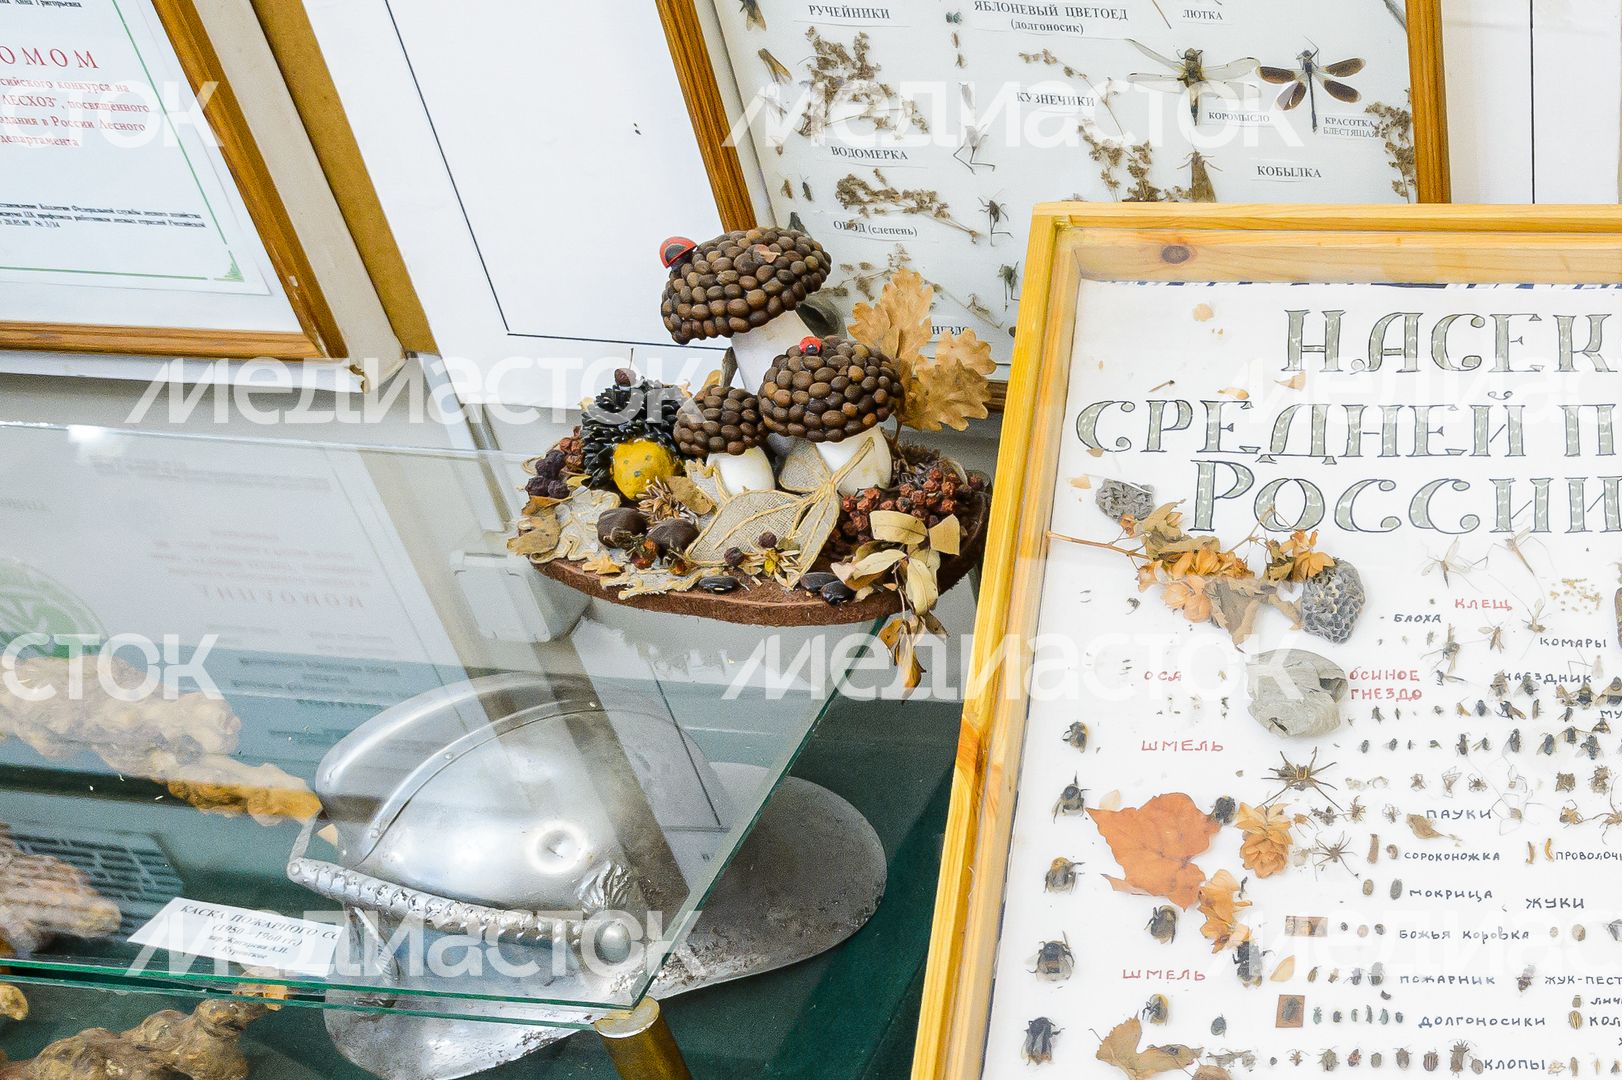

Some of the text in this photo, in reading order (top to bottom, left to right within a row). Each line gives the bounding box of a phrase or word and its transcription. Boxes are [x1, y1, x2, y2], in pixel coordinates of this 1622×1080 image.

[808, 4, 891, 20] РУЧЕЙНИКИ
[973, 0, 1128, 21] ЯБЛОНЕВЫЙ ЦВЕТОЕД
[1182, 9, 1223, 21] ЛЮТКА
[1010, 18, 1085, 34] (долгоносик)
[1016, 91, 1096, 108] КУЗНЕЧИКИ
[1208, 111, 1271, 124] КОРОМЫСЛО
[1324, 117, 1375, 128] КРАСОТКА
[831, 146, 909, 161] ВОДОМЕРКА
[1257, 165, 1322, 179] КОБЫЛКА
[867, 223, 918, 238] (слепень)
[1075, 390, 1527, 465] СРЕДНЕЙ
[1454, 598, 1513, 611] КЛЕЩ
[1393, 612, 1442, 624] БЛОХА
[1540, 637, 1607, 650] КОМАРЫ
[1350, 687, 1423, 703] ГНЕЗДО
[1141, 739, 1225, 752] ШМЕЛЬ
[1425, 807, 1492, 820] ПАУКИ
[1403, 851, 1500, 863] СОРОКОНОЖКА
[1409, 888, 1493, 902] МОКРИЦА
[1525, 897, 1586, 910] ЖУКИ
[1122, 968, 1206, 982] ШМЕЛЬ
[1399, 974, 1496, 986] ПОЖАРНИК
[1418, 1015, 1546, 1029] ДОЛГОНОСИКИ
[1484, 1058, 1547, 1072] КЛОПЫ
